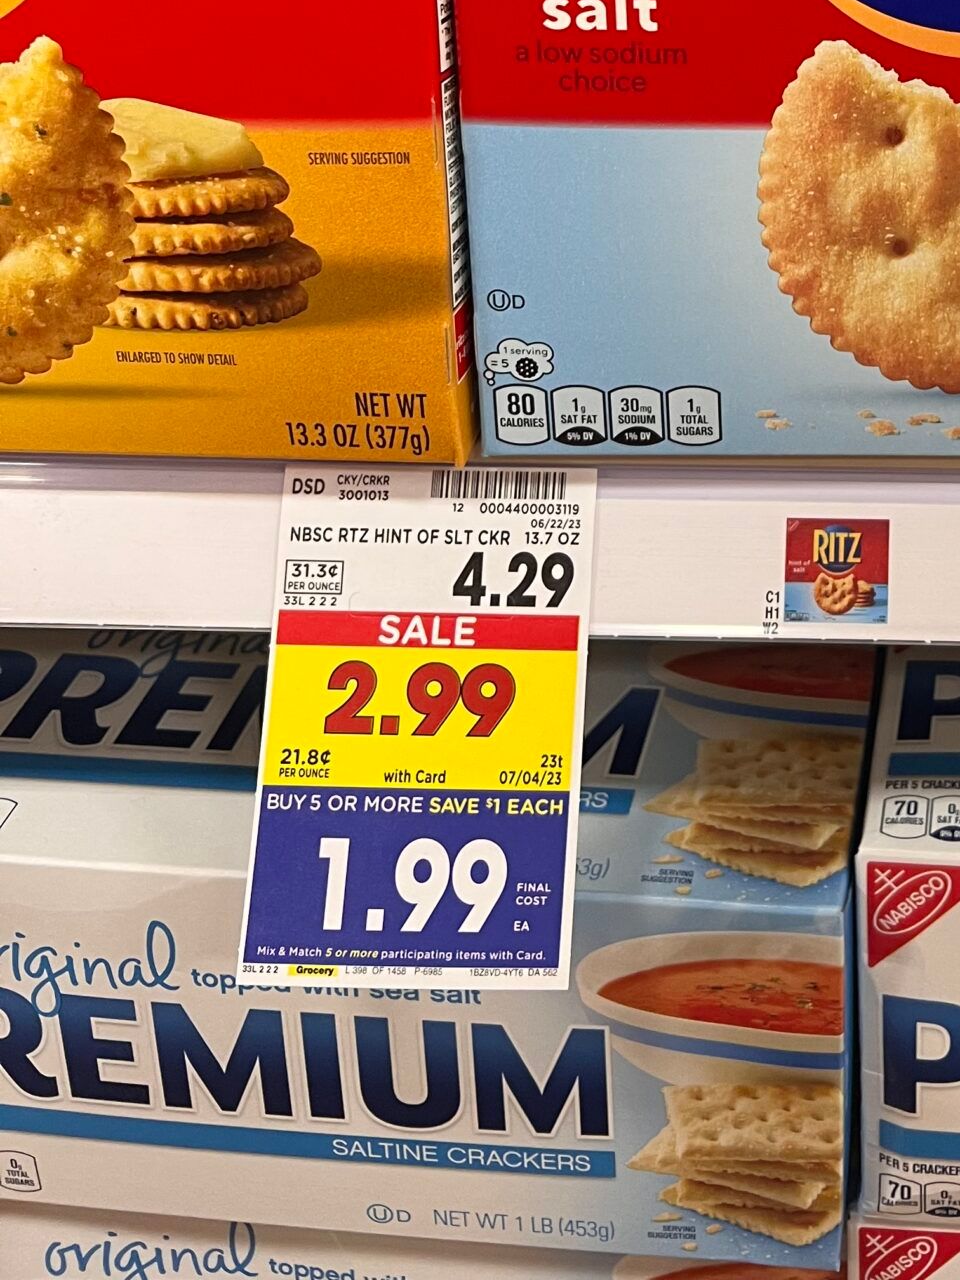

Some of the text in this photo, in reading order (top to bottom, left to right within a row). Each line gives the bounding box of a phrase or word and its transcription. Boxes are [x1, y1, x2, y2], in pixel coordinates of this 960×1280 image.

[515, 40, 688, 65] a low sodium
[558, 67, 647, 93] choice
[308, 151, 410, 165] SERVING SUGGESTION
[116, 351, 237, 366] ENLARGED TO SHOW DETAIL
[355, 392, 427, 419] NET WT
[507, 393, 535, 416] 80
[500, 418, 545, 428] CALORIES
[560, 415, 597, 425] SAT FAT
[618, 415, 656, 425] SODIUM
[680, 415, 708, 425] TOTAL
[676, 426, 714, 436] SUGARS
[285, 422, 431, 456] 13.3 OZ (377g)
[292, 477, 326, 495] DSD
[337, 474, 390, 487] CKY/CRKR
[338, 490, 389, 501] 3001013
[452, 502, 580, 516] 12 0004400003119
[530, 518, 581, 530] 06/22/23
[290, 526, 580, 546] NBSC RTZ HINT OF SLT CKR 13.7 OZ
[813, 528, 862, 564] RITZ
[291, 563, 339, 579] 31.3¢
[287, 581, 340, 592] PER OUNCE
[452, 551, 575, 608] 4.29
[766, 590, 780, 603] C1
[765, 606, 779, 619] H1
[378, 614, 478, 647] SALE
[324, 660, 517, 738] 2.99
[280, 749, 332, 766] 21.8¢
[541, 754, 563, 769] 23t
[279, 768, 330, 779] PER OUNCE
[384, 770, 446, 784] with Card
[499, 771, 562, 786] 07/04/23
[266, 793, 306, 811] BUY
[310, 795, 321, 810] 5
[327, 795, 359, 812] OR
[364, 796, 423, 813] MORE
[429, 797, 480, 814] SAVE
[485, 798, 500, 814] $1
[507, 798, 564, 816] EACH
[894, 800, 918, 815] 70
[318, 837, 508, 933] 1.99
[516, 882, 551, 893] FINAL
[515, 896, 548, 906] COST
[878, 876, 946, 931] NABISCO
[513, 920, 530, 932] EA
[257, 946, 546, 962] Mix & Match 5 or more participating items with Card.
[333, 1138, 592, 1173] SALTINE CRACKERS
[889, 1180, 911, 1200] 70
